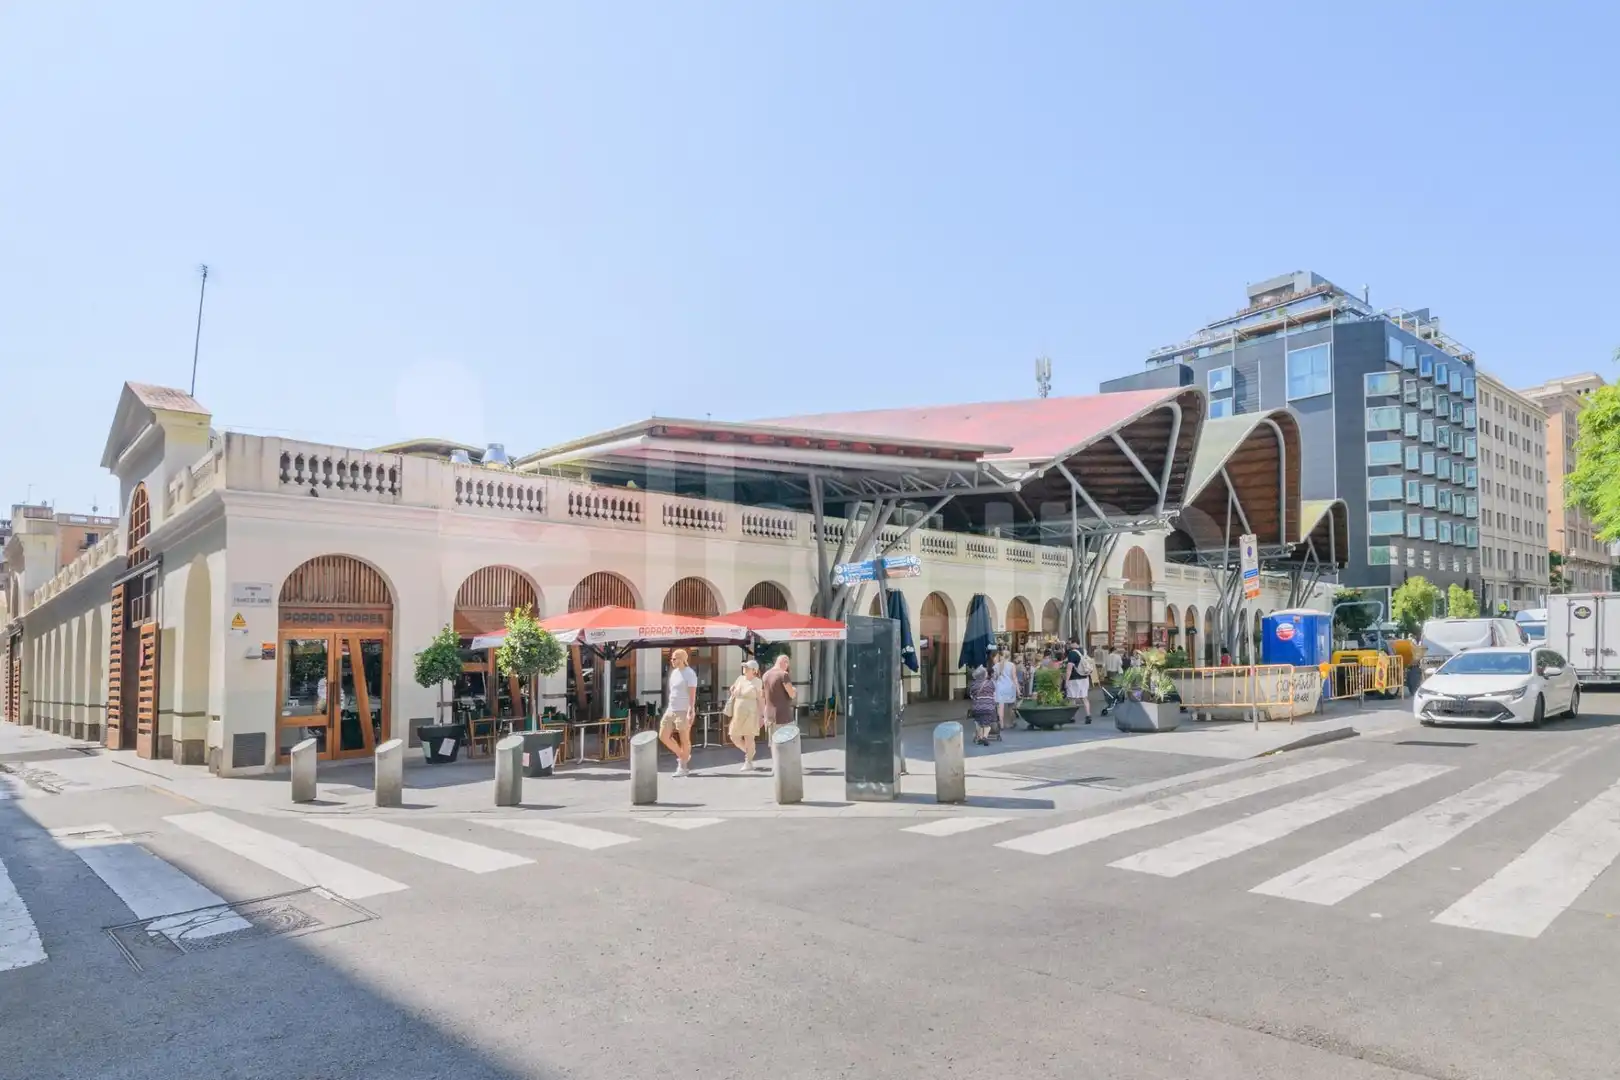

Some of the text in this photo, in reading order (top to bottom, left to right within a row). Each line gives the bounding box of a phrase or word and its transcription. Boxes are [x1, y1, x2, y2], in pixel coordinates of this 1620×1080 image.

[284, 613, 384, 624] PARADA TORRES
[638, 626, 705, 636] PARADA TORRES
